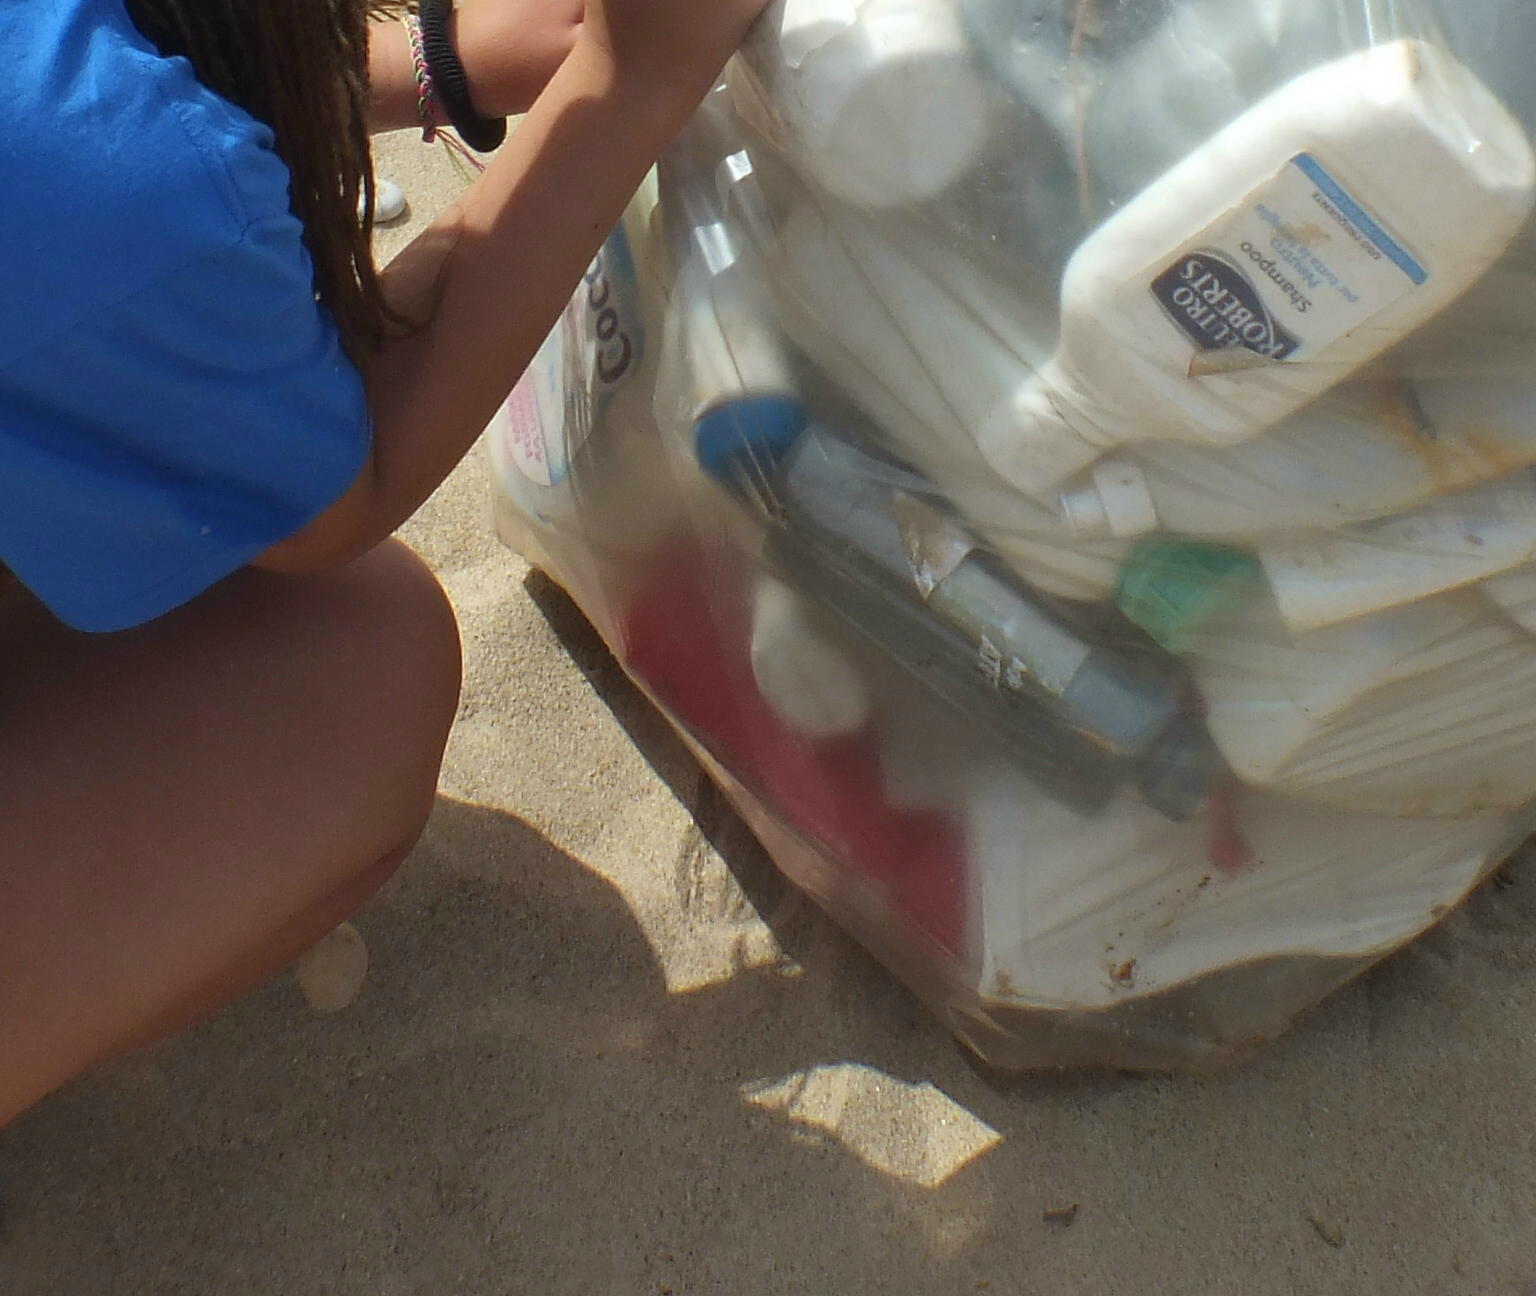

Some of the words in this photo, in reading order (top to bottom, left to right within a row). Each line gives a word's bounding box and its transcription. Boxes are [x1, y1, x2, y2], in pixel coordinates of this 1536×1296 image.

[1240, 241, 1312, 314] Shampoo
[1269, 238, 1320, 288] Neutro
[1172, 287, 1241, 350] EUTRO
[1179, 260, 1284, 355] ROBERTS
